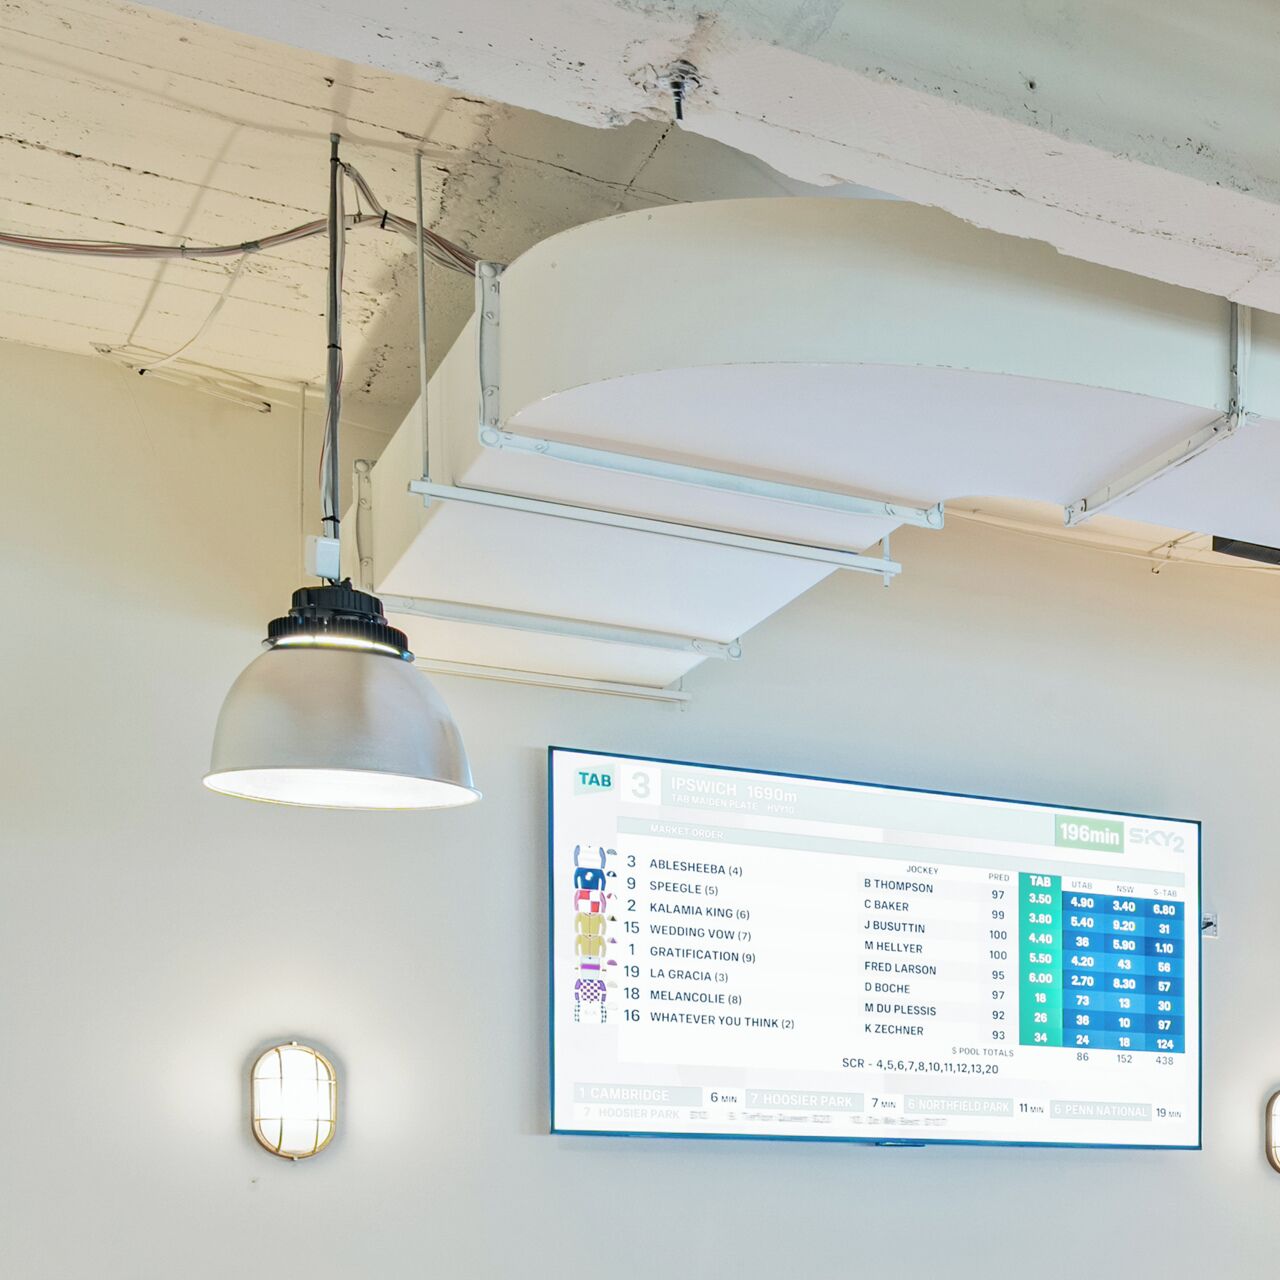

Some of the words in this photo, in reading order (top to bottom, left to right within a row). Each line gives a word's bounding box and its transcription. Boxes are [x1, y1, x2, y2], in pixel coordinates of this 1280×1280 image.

[579, 772, 612, 788] TAB
[631, 771, 650, 799] 3
[671, 777, 737, 796] IPSWICH
[747, 785, 797, 803] 1690m
[650, 824, 690, 836] MARKET
[692, 828, 724, 840] ORDER
[1060, 822, 1120, 846] 196min
[1129, 828, 1185, 853] SKY2
[626, 855, 636, 868] 3
[650, 858, 726, 875] ABLESHEEBA
[728, 866, 742, 877] (4)
[906, 865, 939, 875] JOCKEY
[988, 873, 1010, 882] PRED
[1029, 876, 1051, 888] TAB
[626, 877, 636, 890] 9
[650, 881, 702, 894] SPEEGLE
[704, 886, 718, 896] (5)
[864, 878, 872, 888] B
[874, 879, 934, 894] THOMPSON
[1071, 881, 1093, 890] UTAB
[992, 890, 1005, 900] 97
[1028, 893, 1052, 905] 3.50
[627, 900, 636, 912] 2
[650, 902, 703, 916] KALAMIA
[706, 907, 733, 918] KING
[736, 910, 750, 920] (6)
[864, 900, 872, 909] C
[874, 900, 909, 912] BAKER
[1112, 900, 1136, 912] 3.40
[992, 910, 1005, 920] 99
[1028, 913, 1052, 924] 3.80
[624, 922, 640, 934] 15
[650, 924, 705, 938] WEDDING
[708, 929, 736, 940] VOW
[738, 932, 752, 942] (7)
[864, 920, 870, 930] J
[873, 921, 926, 934] BUSUTTIN
[1159, 924, 1170, 935] 31
[990, 930, 1008, 940] 100
[1028, 933, 1052, 944] 4.40
[864, 941, 874, 950] M
[876, 942, 923, 954] HELLYER
[1155, 943, 1174, 954] 1.10
[650, 946, 739, 962] GRATIFICATION
[742, 953, 756, 964] (9)
[990, 950, 1008, 960] 100
[1028, 952, 1052, 964] 5.50
[1070, 956, 1094, 968] 4.20
[1118, 960, 1132, 970] 43
[624, 966, 640, 978] 19
[650, 968, 665, 978] LA
[668, 970, 712, 982] GRACIA
[714, 972, 728, 984] (3)
[864, 962, 892, 972] FRED
[894, 964, 937, 976] LARSON
[992, 970, 1005, 980] 95
[1028, 972, 1052, 984] 6.00
[1070, 976, 1094, 988] 2.70
[864, 982, 872, 992] D
[874, 983, 910, 994] BOCHE
[1158, 981, 1171, 992] 57
[624, 988, 640, 1000] 18
[650, 990, 725, 1004] MELANCOLIE
[728, 994, 742, 1006] (8)
[992, 990, 1005, 1000] 97
[1034, 993, 1046, 1003] 18
[1076, 996, 1090, 1006] 73
[864, 1003, 874, 1012] M
[876, 1004, 891, 1014] DU
[894, 1004, 937, 1016] PLESSIS
[1119, 998, 1131, 1009] 13
[1158, 1001, 1171, 1012] 30
[624, 1010, 640, 1022] 16
[650, 1012, 715, 1026] WHATEVER
[718, 1016, 742, 1027] YOU
[744, 1017, 778, 1028] THINK
[782, 1020, 795, 1030] (2)
[992, 1010, 1005, 1020] 92
[1034, 1012, 1047, 1023] 26
[1119, 1018, 1131, 1028] 10
[864, 1024, 872, 1033] K
[874, 1024, 924, 1036] ZECHNER
[992, 1030, 1005, 1040] 93
[1034, 1032, 1047, 1043] 34
[1076, 1034, 1090, 1046] 24
[1156, 1039, 1174, 1050] 124
[959, 1047, 980, 1056] POOL
[982, 1048, 1014, 1058] TOTALS
[1076, 1052, 1089, 1062] 86
[1116, 1054, 1133, 1064] 152
[1156, 1056, 1174, 1066] 438
[842, 1058, 864, 1068] SCR
[876, 1060, 999, 1075] 4,5,6,7,8,10,11,12,13,20
[590, 1088, 669, 1102] CAMBRIDGE
[710, 1092, 718, 1102] 6
[764, 1094, 818, 1106] HOOSIER
[821, 1096, 853, 1107] PARK
[872, 1098, 878, 1108] 7
[881, 1100, 896, 1108] MIN
[918, 1098, 981, 1112] NORTHFIELD
[984, 1101, 1009, 1112] PARK
[1020, 1103, 1028, 1112] 11
[598, 1108, 648, 1119] HOOSIER
[650, 1109, 680, 1120] PARK
[1066, 1104, 1095, 1116] PENN
[1096, 1106, 1148, 1118] NATIONAL
[1156, 1108, 1167, 1118] 19
